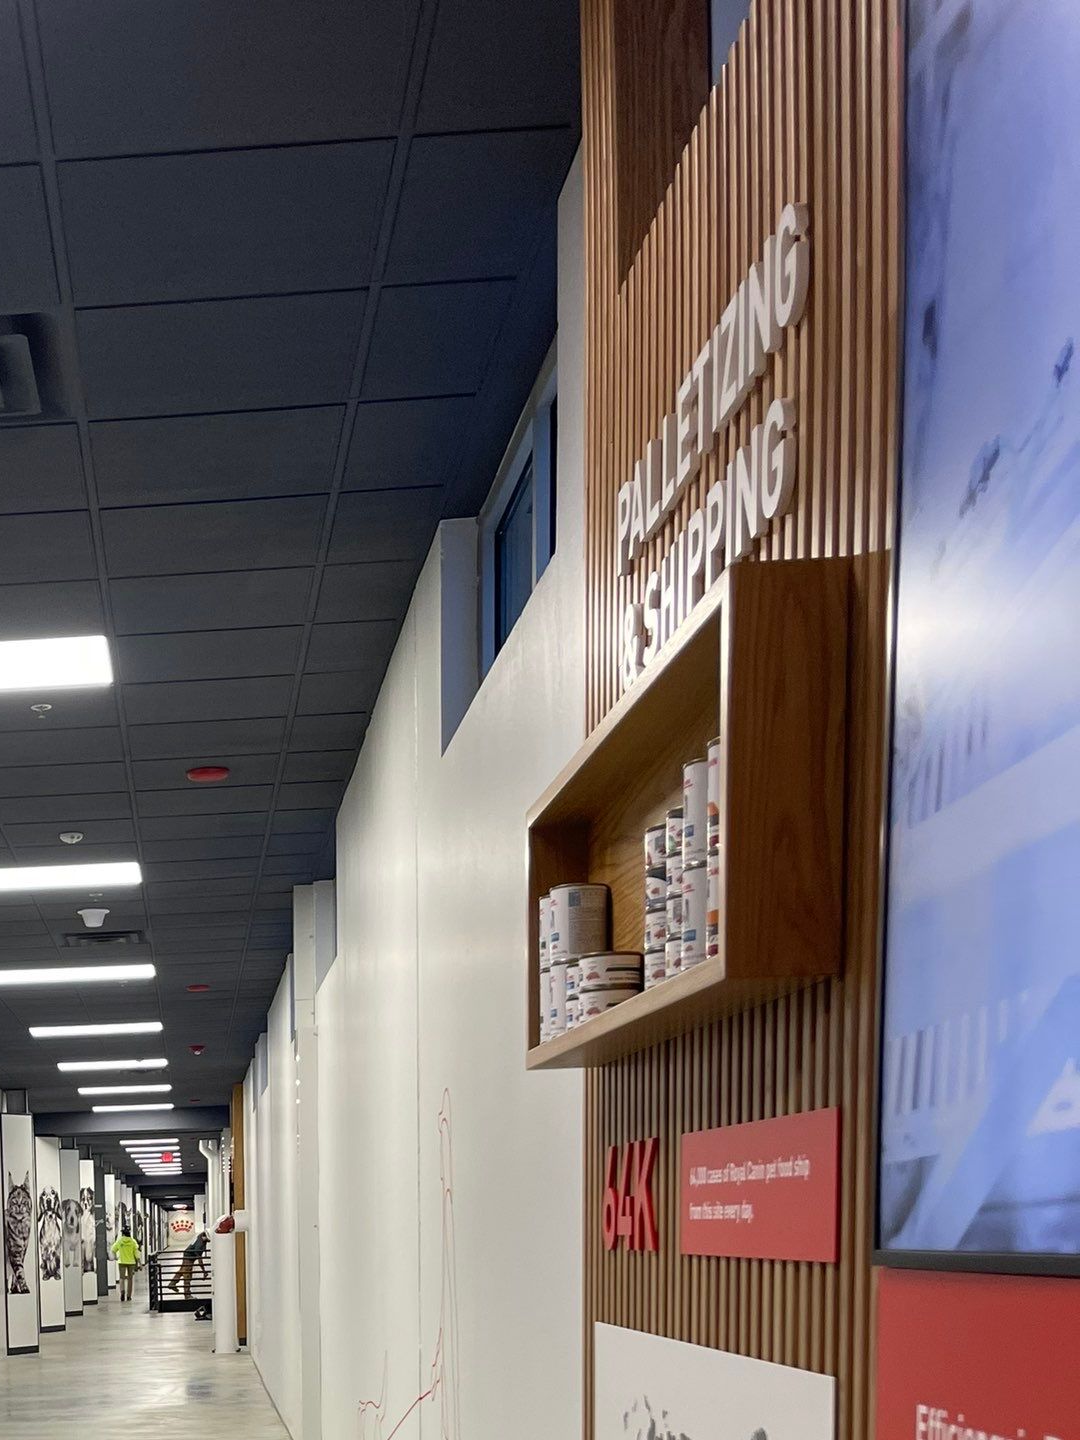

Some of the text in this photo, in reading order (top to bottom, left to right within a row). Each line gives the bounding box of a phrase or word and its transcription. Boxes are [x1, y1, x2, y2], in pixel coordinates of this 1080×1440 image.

[618, 201, 811, 577] PALLETIZING
[621, 398, 797, 691] & SHIPPING
[603, 1136, 659, 1252] 64K
[689, 1202, 702, 1220] from
[702, 1201, 712, 1219] this
[713, 1200, 723, 1219] site
[724, 1203, 740, 1223] every
[707, 1169, 722, 1183] cases
[731, 1162, 746, 1186] Royal
[766, 1160, 777, 1183] pet
[777, 1156, 793, 1177] food
[794, 1154, 811, 1181] ship
